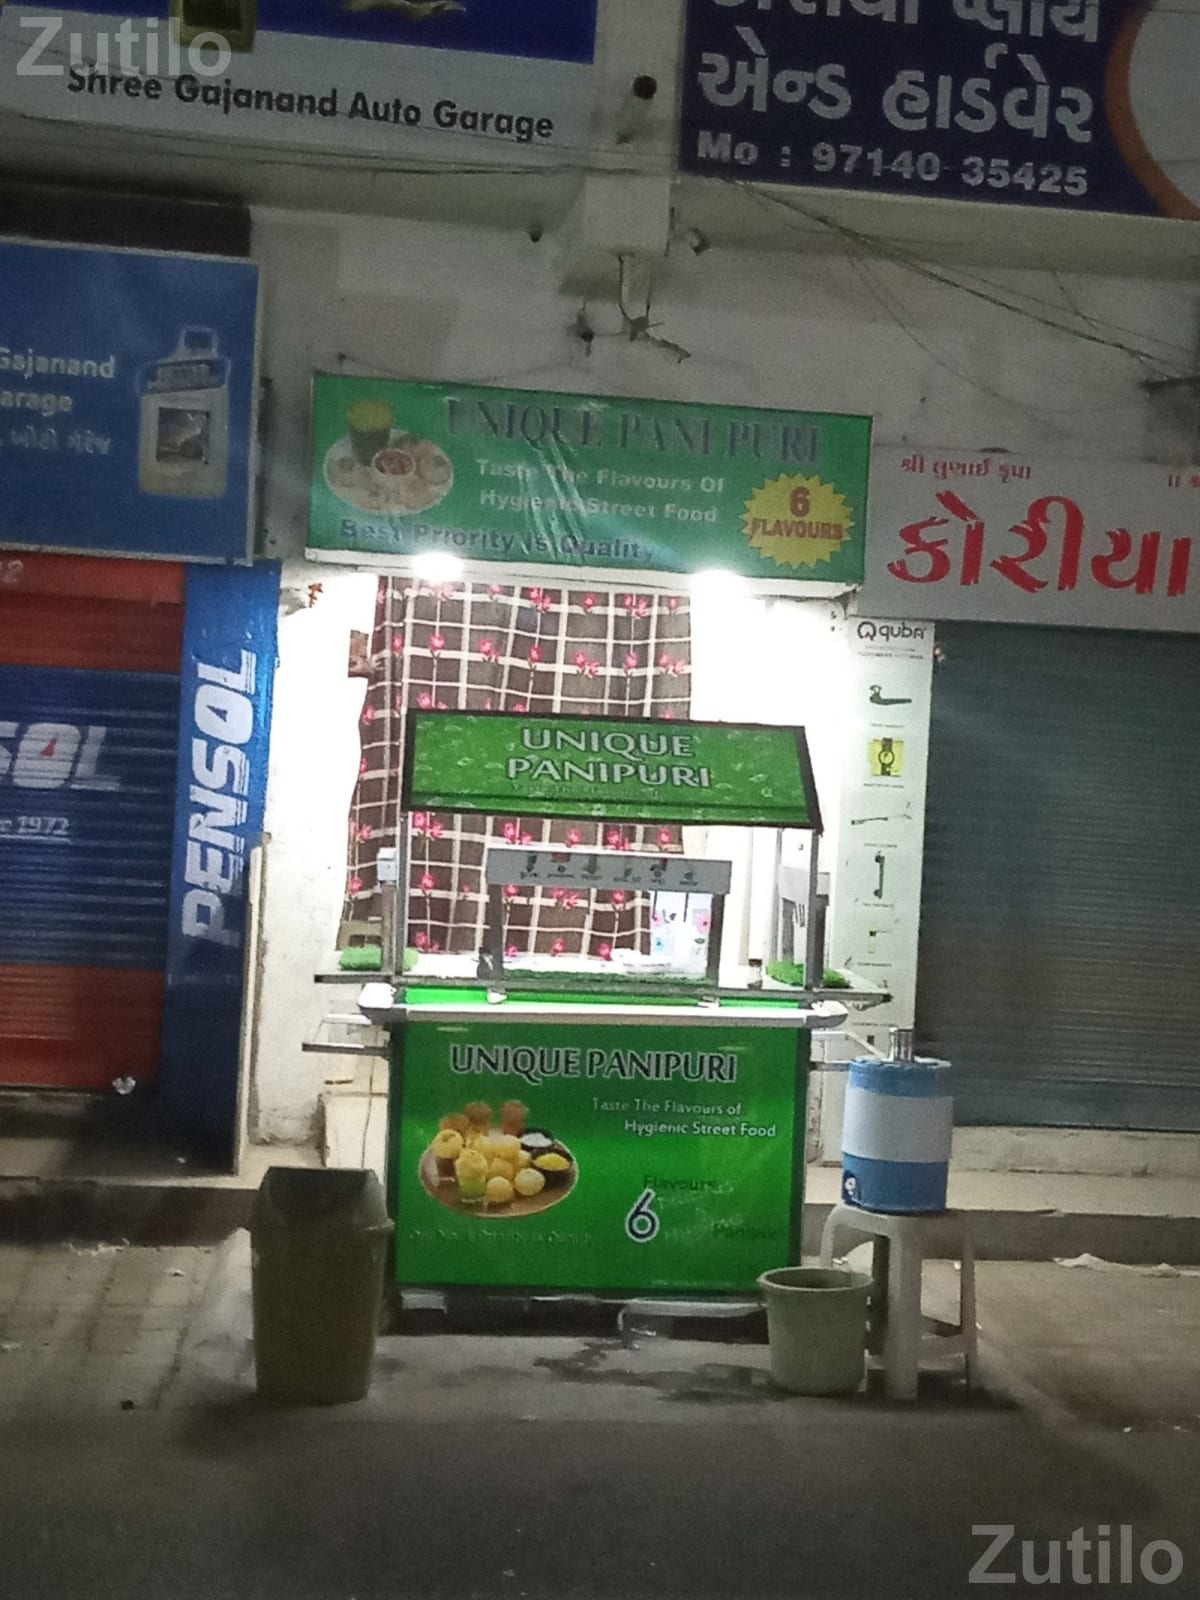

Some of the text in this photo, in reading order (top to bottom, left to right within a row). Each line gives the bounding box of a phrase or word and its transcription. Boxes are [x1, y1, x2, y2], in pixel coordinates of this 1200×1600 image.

[67, 64, 555, 142] Shree Gajanand Auto Garage
[697, 131, 758, 164] Mo
[811, 142, 941, 182] 97140
[961, 156, 1089, 196] 35425
[726, 419, 821, 464] PURI
[596, 468, 693, 491] Flavours
[700, 475, 726, 493] Of
[587, 496, 656, 518] Street
[664, 502, 718, 523] Food
[789, 486, 811, 518] 6
[413, 522, 515, 552] Priority
[559, 535, 653, 563] Quality
[751, 517, 844, 541] FLAVOURS
[886, 490, 1193, 598] કોરીયા
[521, 726, 696, 762] UNIQUE
[506, 757, 713, 790] PANIPURI
[181, 648, 257, 948] PENSOL
[17, 814, 71, 836] 1972
[450, 1043, 738, 1086] UNIQUE PANIPURI
[593, 1096, 742, 1116] Taste The Flavours of
[624, 1119, 777, 1138] Hygienic Street Food
[624, 1187, 660, 1244] 6
